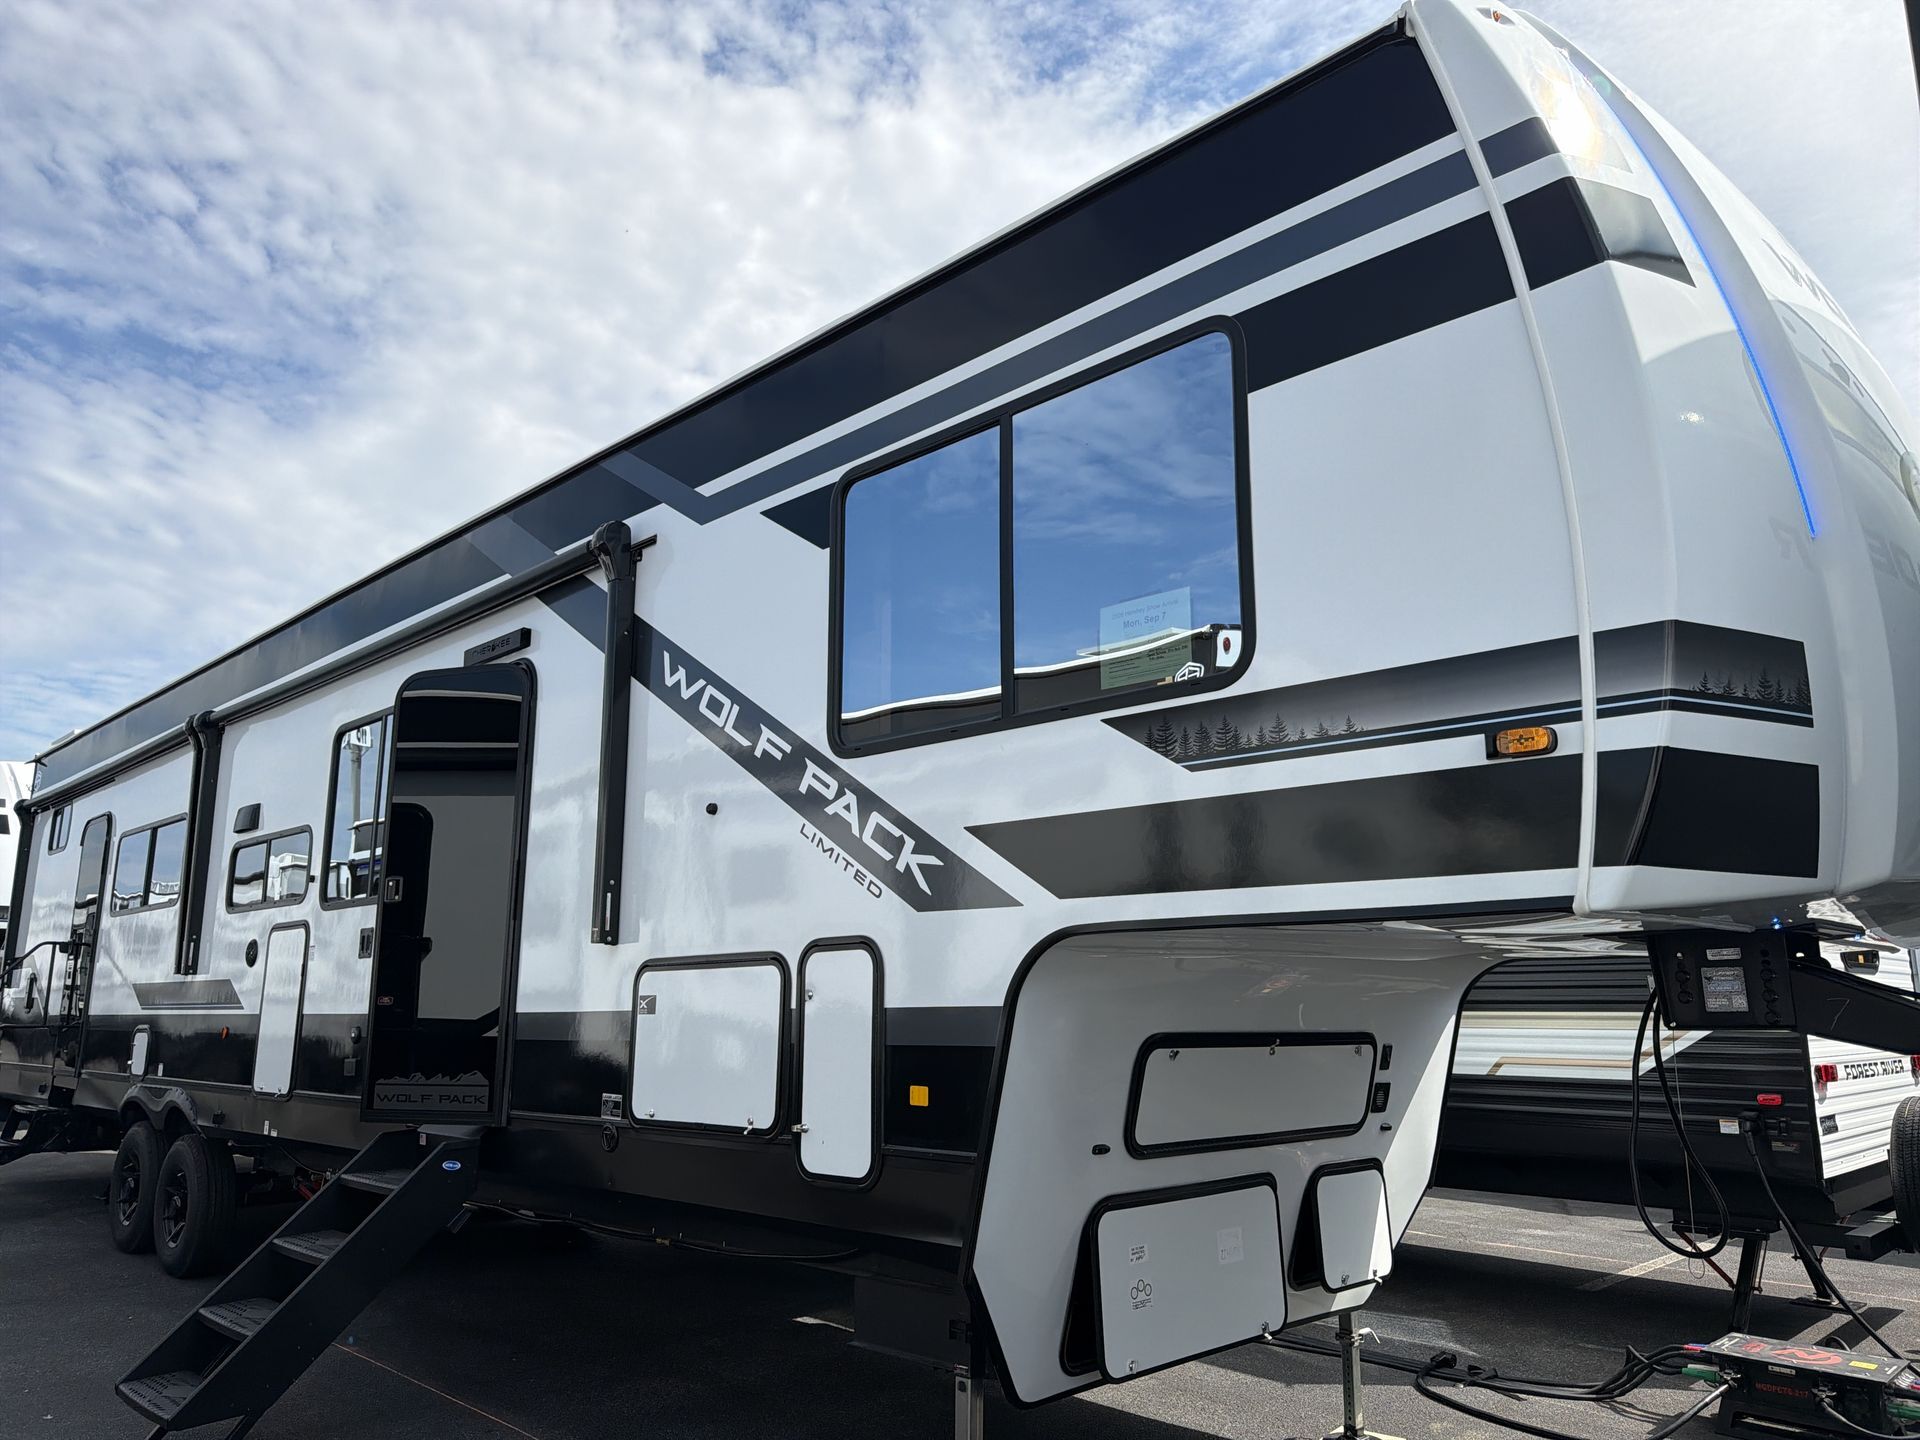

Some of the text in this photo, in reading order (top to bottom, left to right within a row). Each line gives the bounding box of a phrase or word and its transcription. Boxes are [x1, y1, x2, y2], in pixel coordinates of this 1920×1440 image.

[1144, 614, 1160, 624] Sep
[662, 649, 945, 896] WOLF PACK
[799, 822, 884, 899] LIMITED
[1843, 1058, 1905, 1081] FOREST RIVER
[375, 1092, 486, 1105] WOLF PACK
